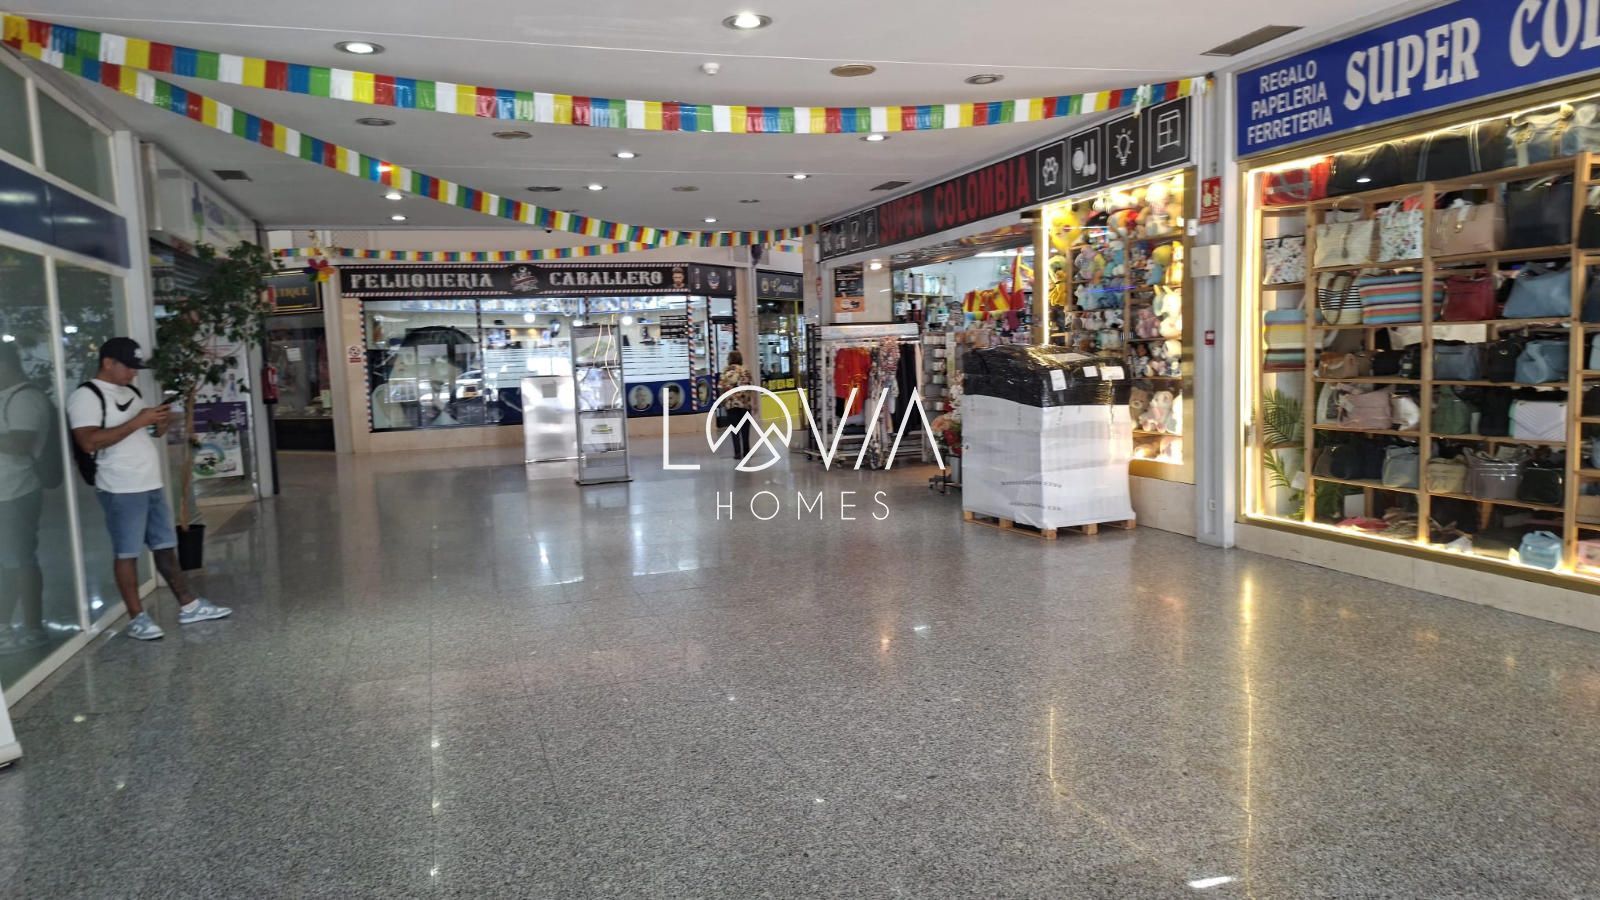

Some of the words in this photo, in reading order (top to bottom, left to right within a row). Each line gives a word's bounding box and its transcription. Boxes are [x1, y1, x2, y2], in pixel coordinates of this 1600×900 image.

[1259, 60, 1318, 94] REGALO
[1343, 17, 1480, 111] SUPER
[1251, 81, 1328, 120] PAPELERIA
[1246, 105, 1334, 146] FERRETERIA
[878, 195, 924, 242] SUPER
[934, 155, 1031, 230] COLOMBIA
[350, 273, 494, 289] PELUQUERIA
[549, 271, 664, 287] CABALLERO
